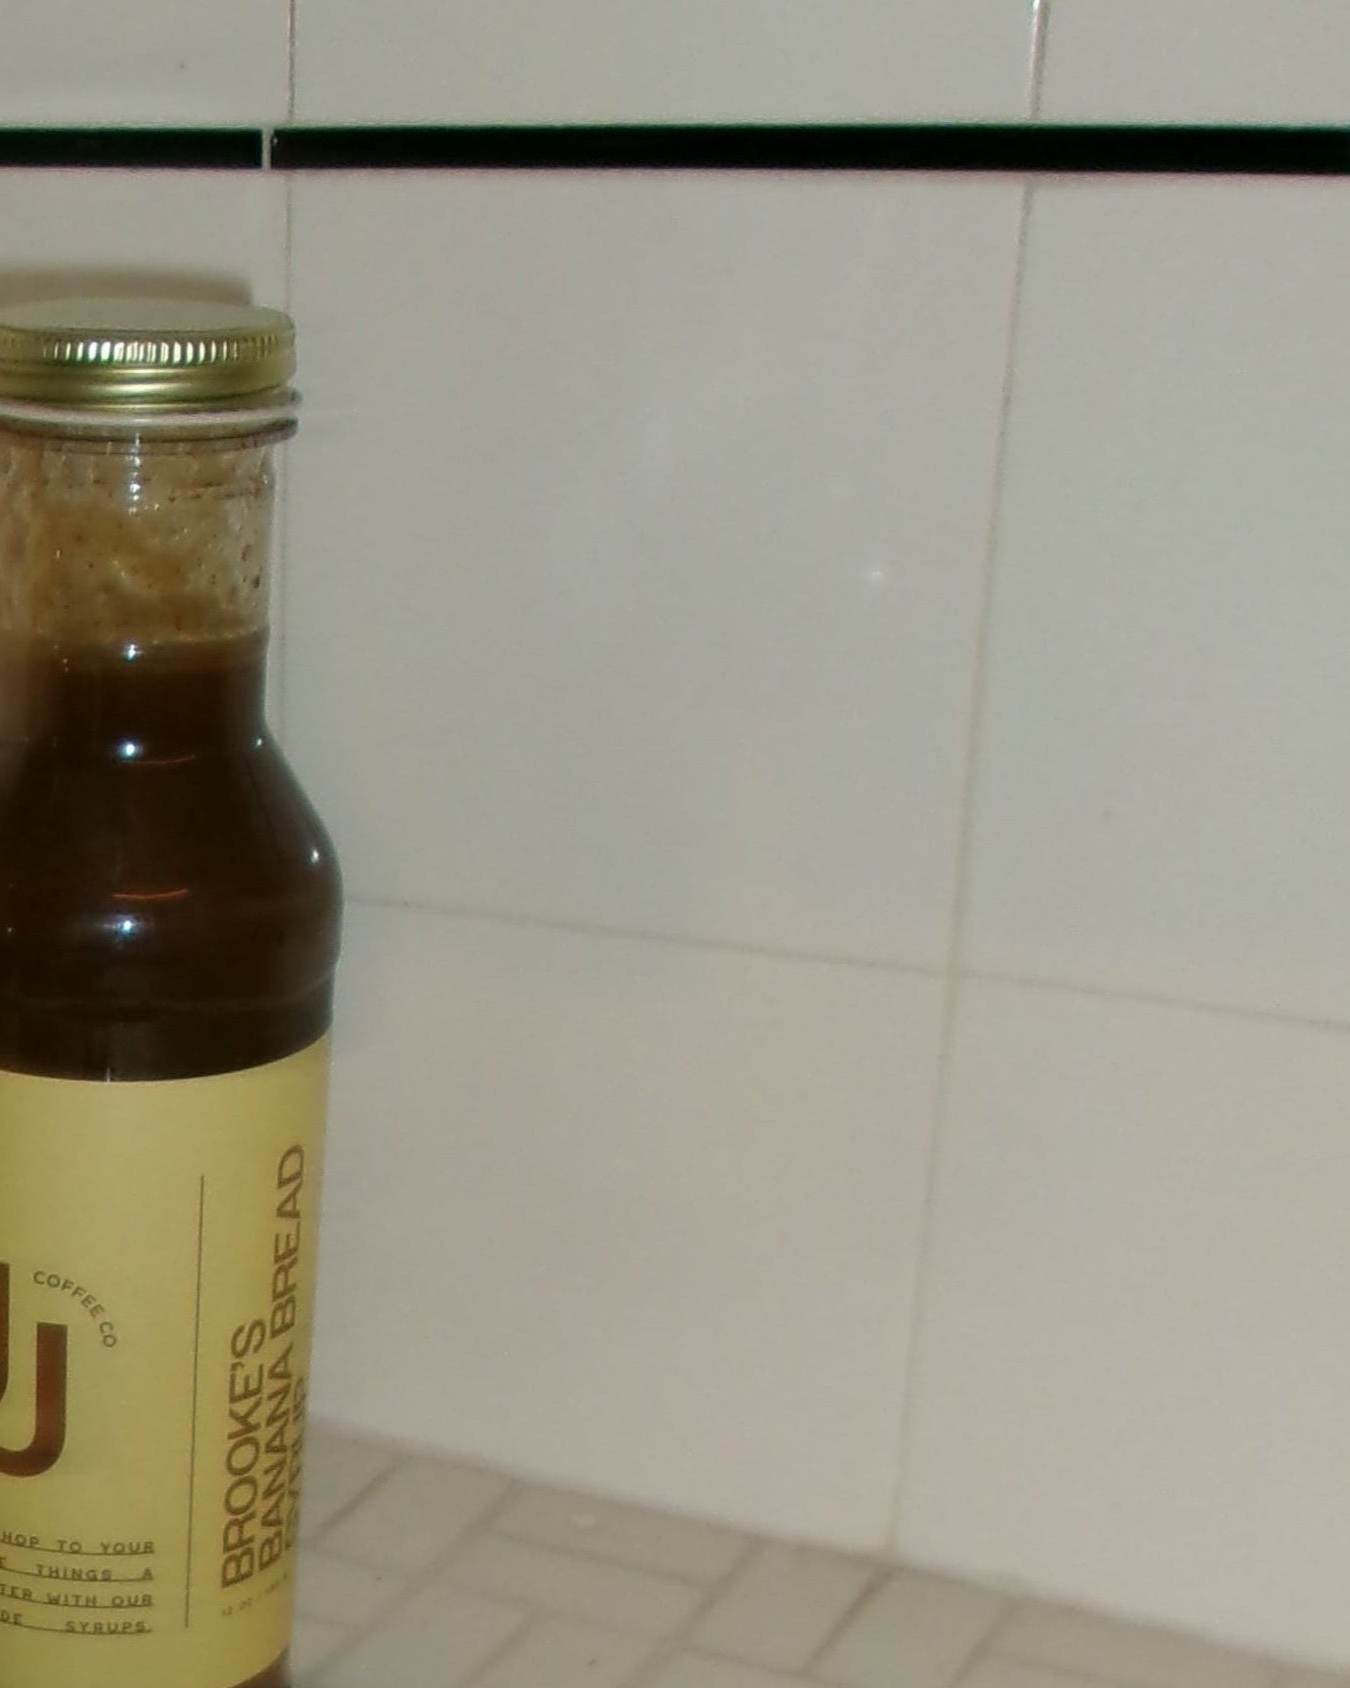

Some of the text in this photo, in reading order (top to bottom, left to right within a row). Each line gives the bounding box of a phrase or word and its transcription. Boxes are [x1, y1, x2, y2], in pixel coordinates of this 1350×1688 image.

[270, 1144, 305, 1340] BREAD
[33, 1270, 117, 1348] COFFEE CO
[221, 1318, 266, 1588] BROOKE'S
[258, 1341, 293, 1572] BANANA
[36, 1563, 113, 1581] THINGS
[142, 1567, 155, 1580] A
[58, 1539, 83, 1553] TO
[100, 1541, 155, 1555] YOUR
[47, 1592, 97, 1607] WITH
[111, 1594, 154, 1607] OUR
